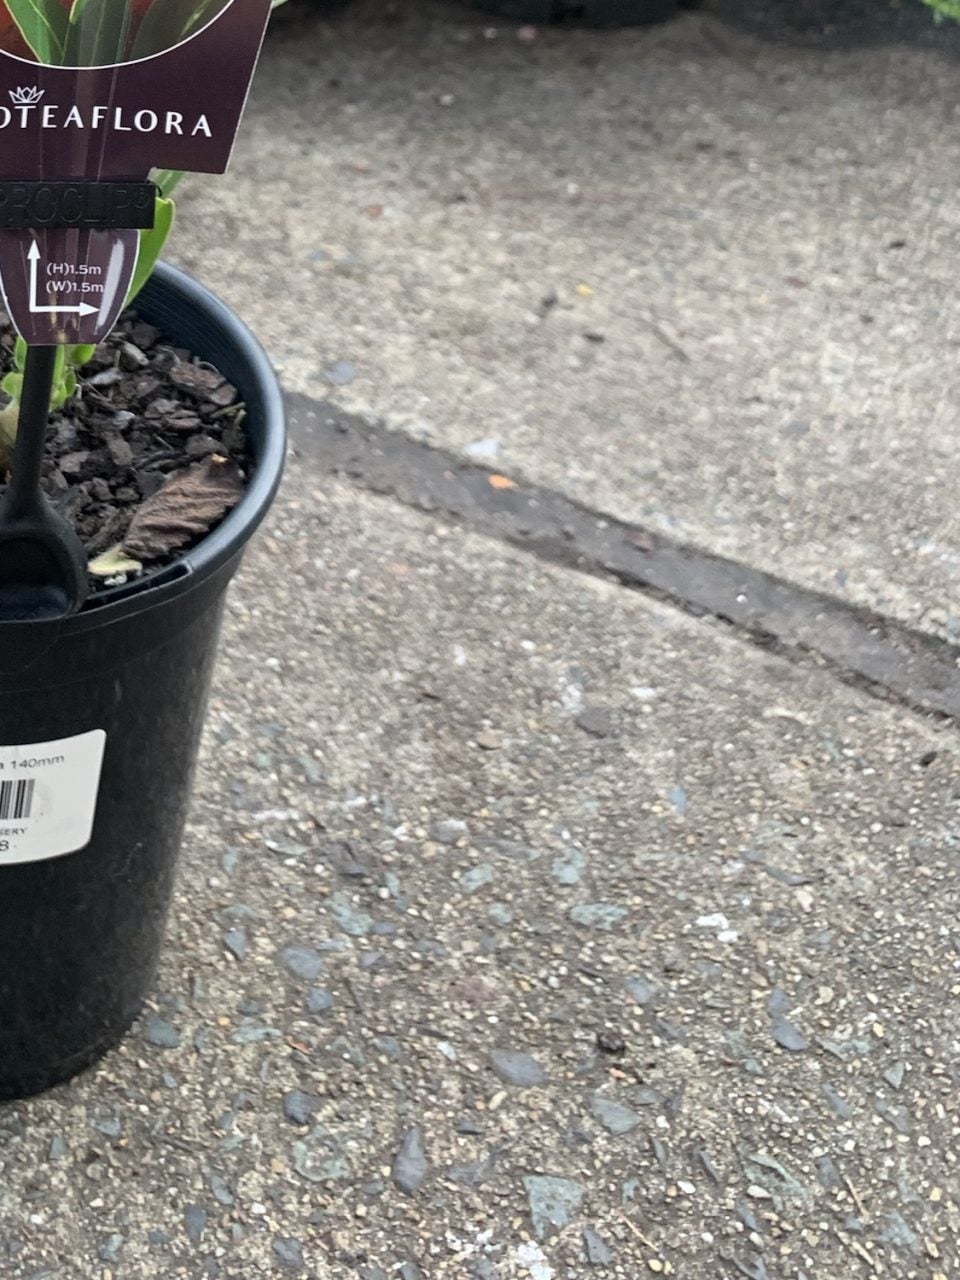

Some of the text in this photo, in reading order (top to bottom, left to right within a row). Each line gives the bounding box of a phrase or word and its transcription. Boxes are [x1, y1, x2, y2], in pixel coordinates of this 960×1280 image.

[46, 262, 102, 276] (H)1.5m
[46, 280, 104, 294] (W)1.5m
[10, 755, 65, 769] 140mm
